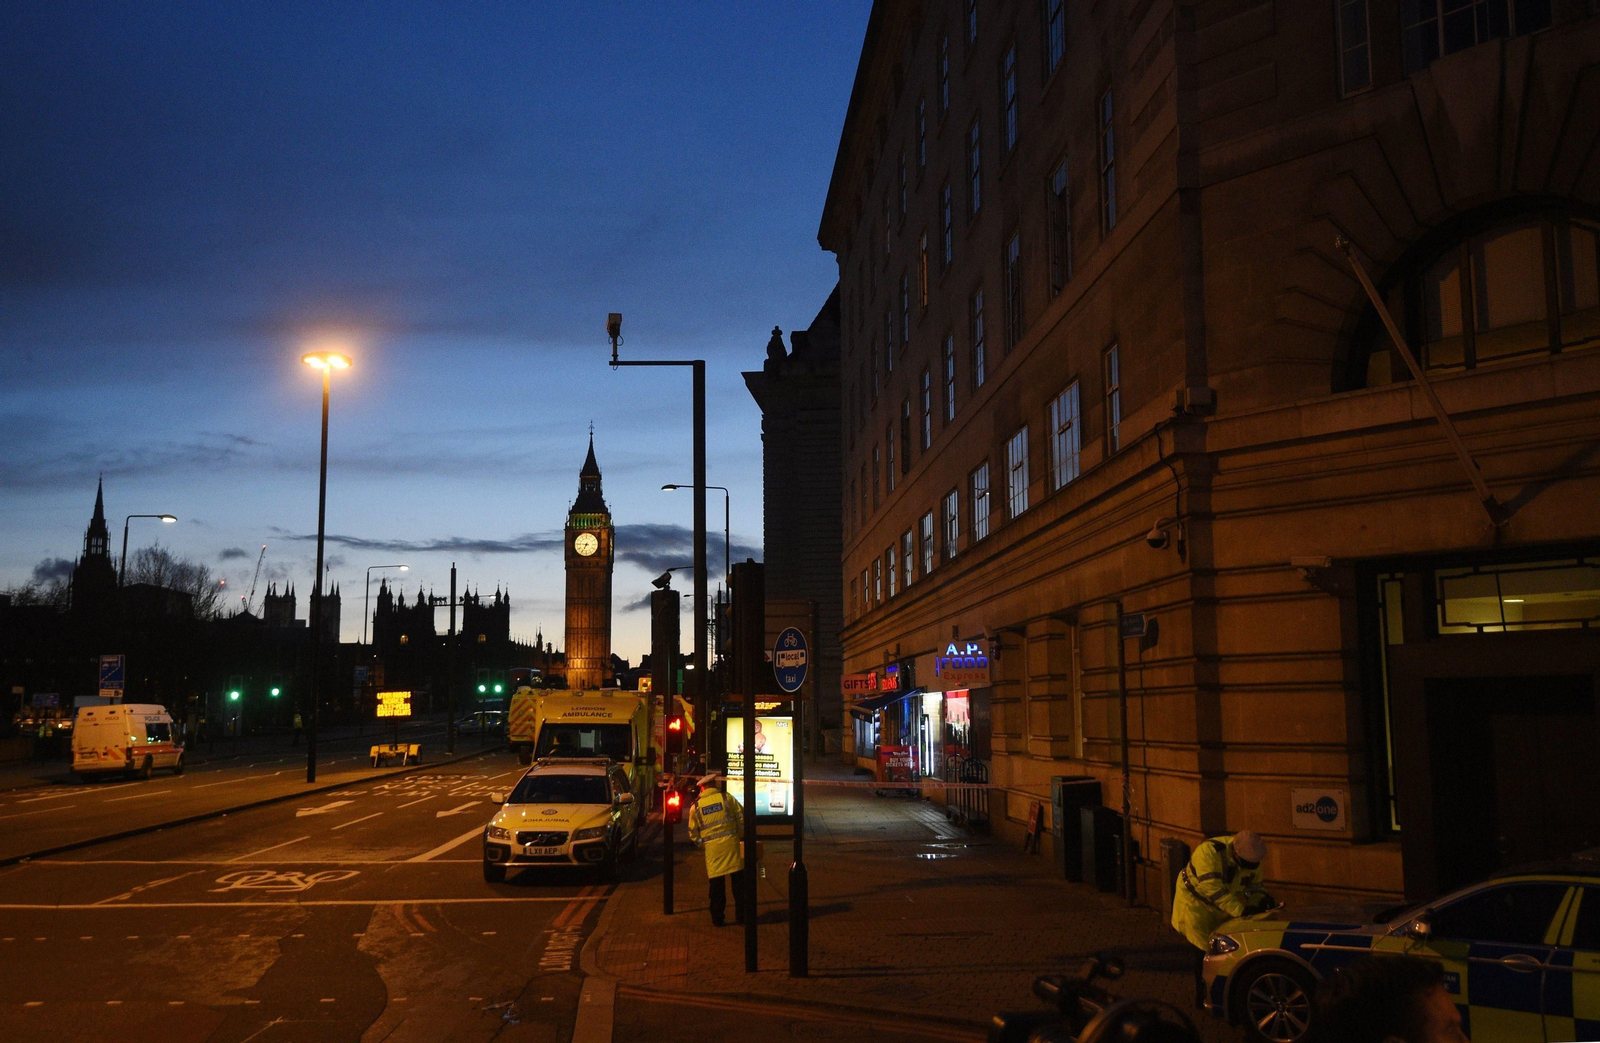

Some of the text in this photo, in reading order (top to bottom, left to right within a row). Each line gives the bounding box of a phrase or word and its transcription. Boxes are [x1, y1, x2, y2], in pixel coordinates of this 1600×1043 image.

[946, 642, 983, 656] A.P.
[785, 652, 800, 661] local
[941, 656, 988, 669] FOOD
[785, 674, 797, 683] taxi
[943, 671, 986, 681] Express
[843, 679, 869, 690] GIFTS
[561, 711, 613, 719] AMBULANCE
[703, 803, 723, 814] POLICE
[529, 847, 558, 855] LX11 AEP
